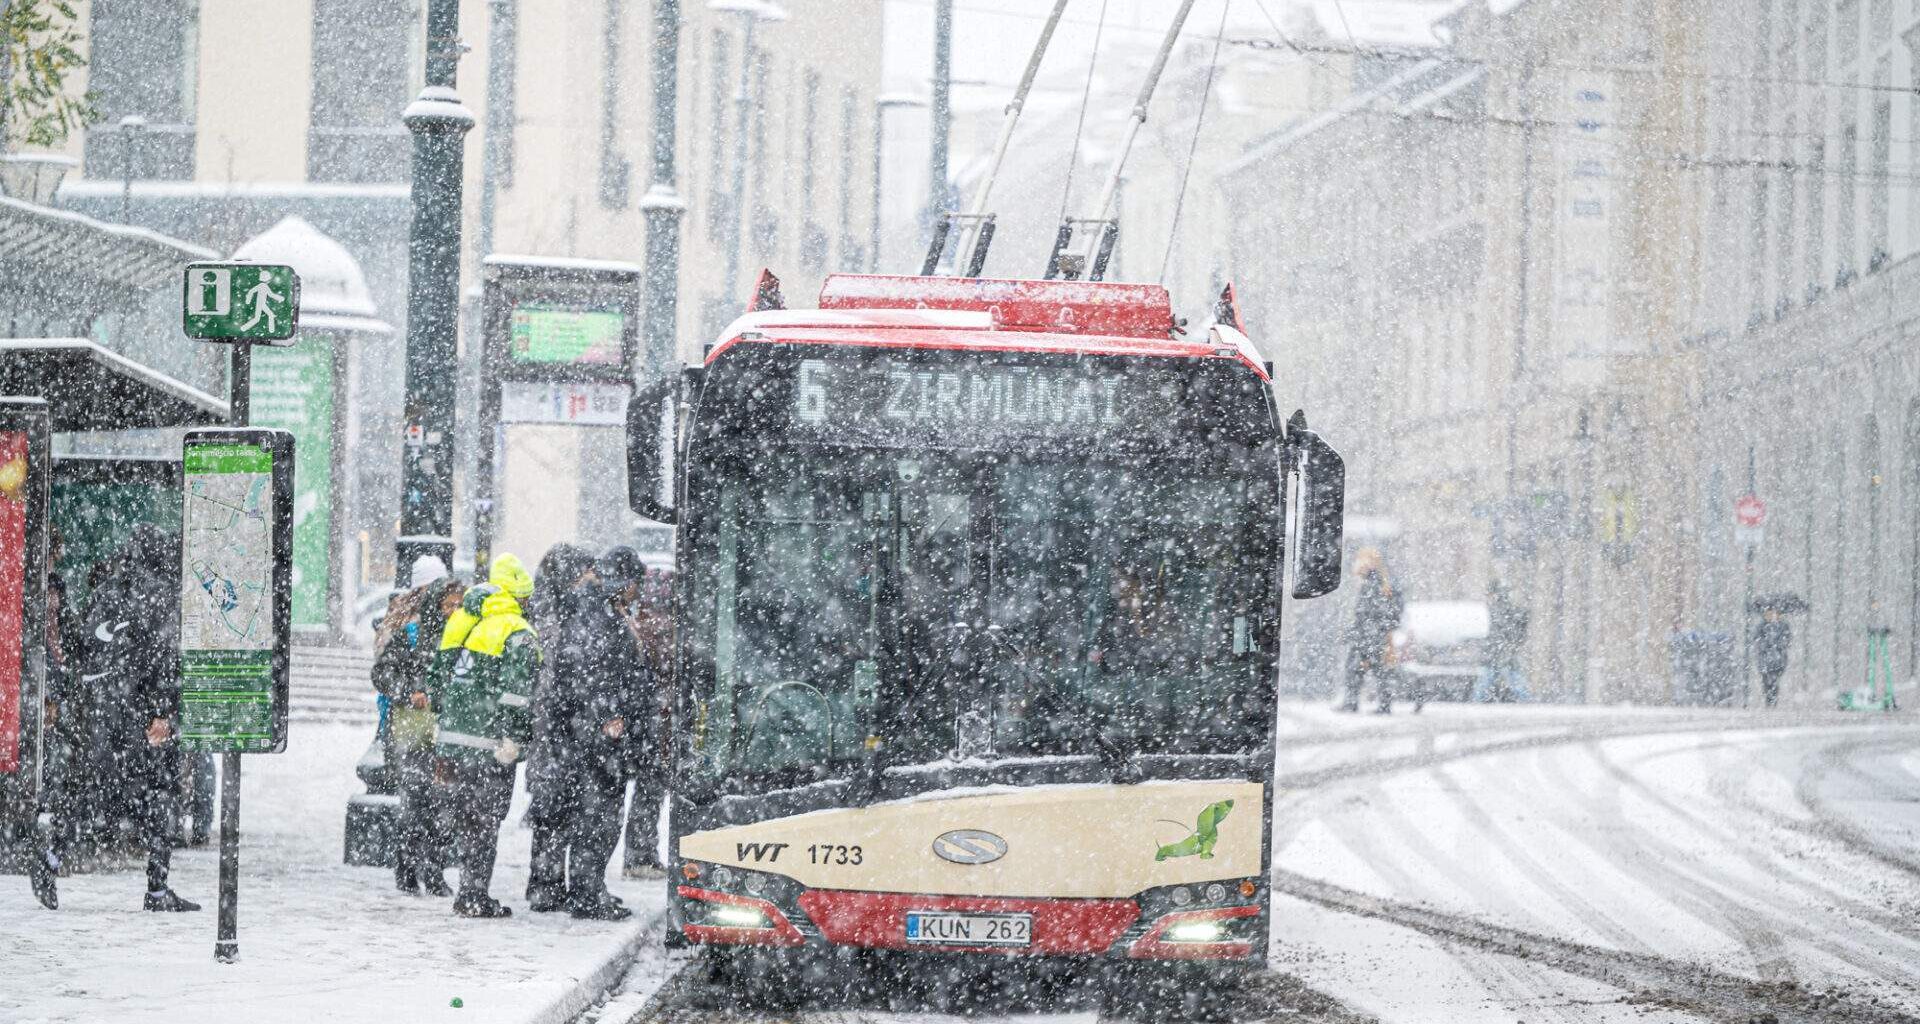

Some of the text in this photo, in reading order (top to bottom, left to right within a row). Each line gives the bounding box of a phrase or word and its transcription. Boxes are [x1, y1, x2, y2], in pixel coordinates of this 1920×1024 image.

[799, 359, 1120, 424] 6 ŽIRMŪNAI
[736, 843, 863, 865] VVT 1733
[922, 918, 1026, 940] KUN 262
